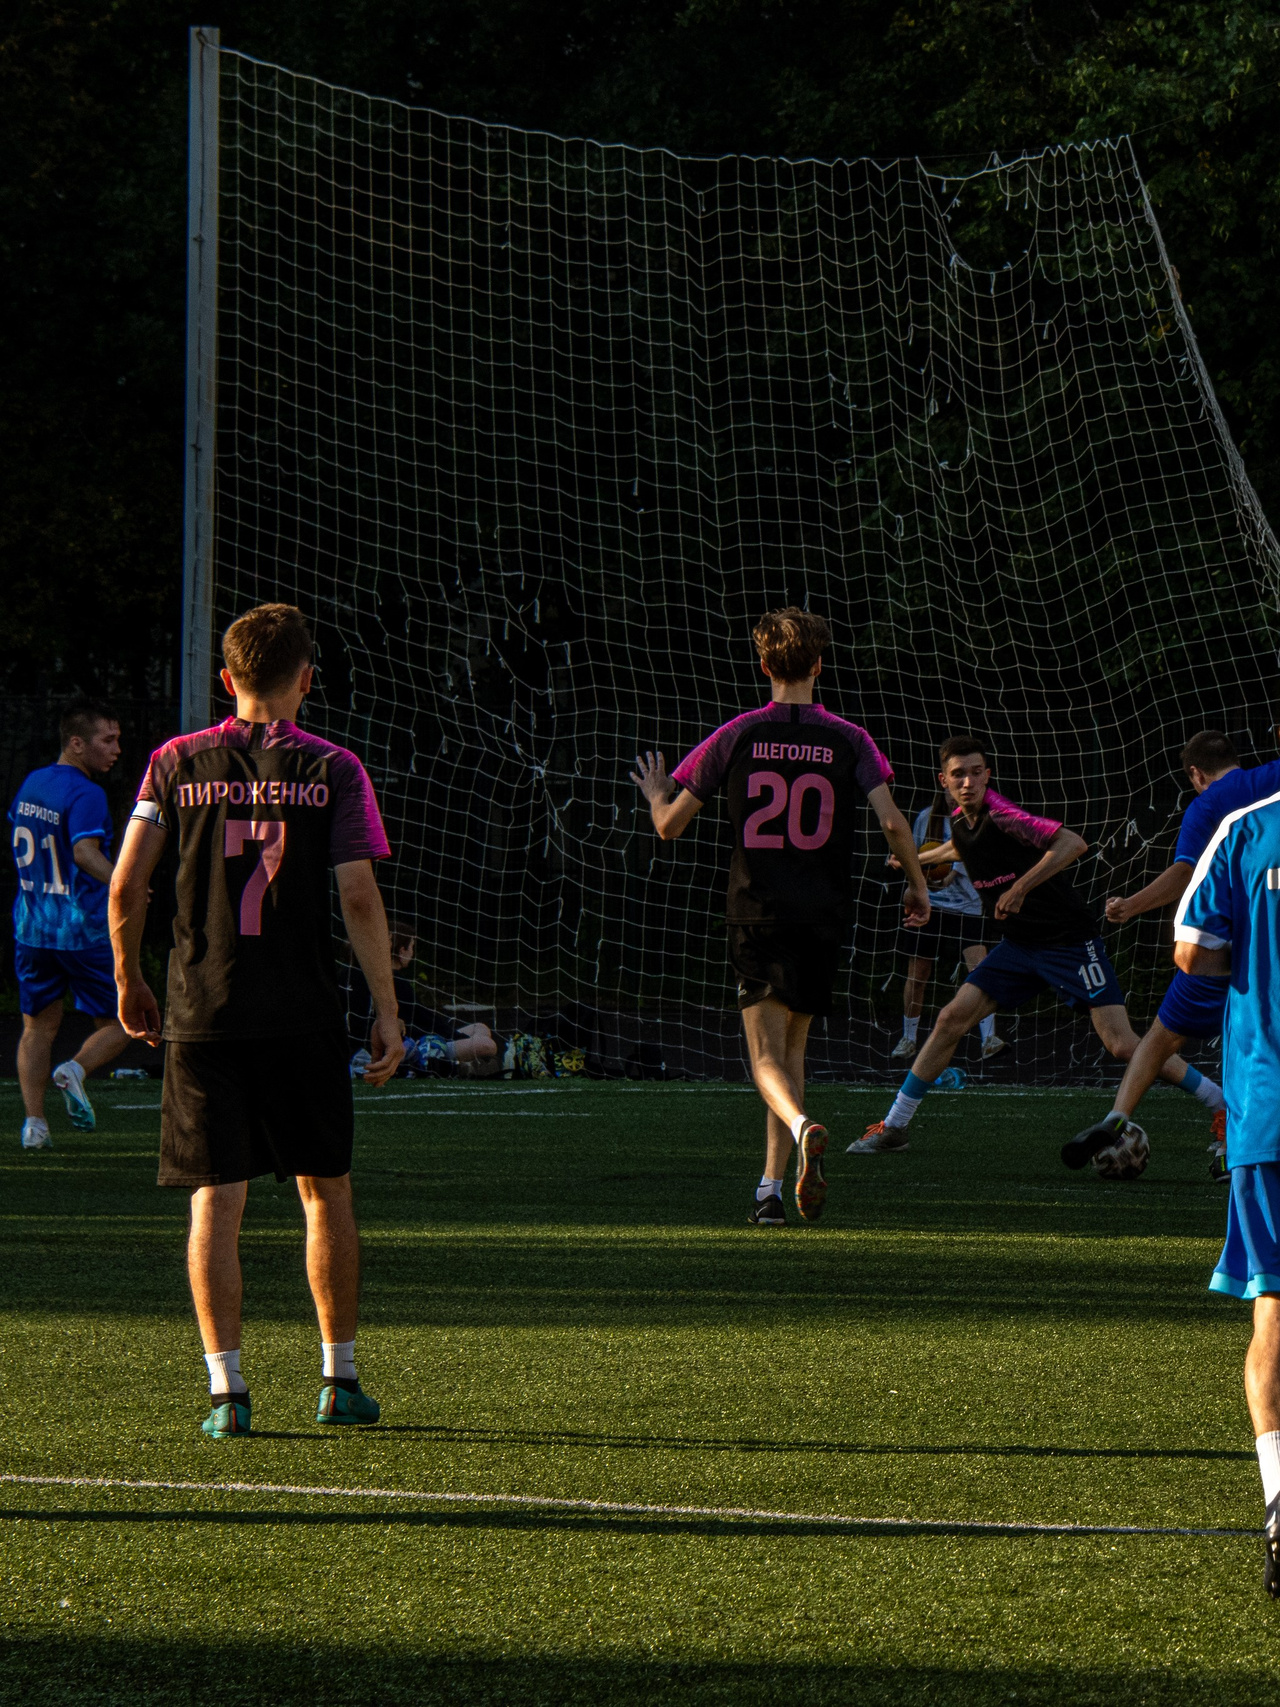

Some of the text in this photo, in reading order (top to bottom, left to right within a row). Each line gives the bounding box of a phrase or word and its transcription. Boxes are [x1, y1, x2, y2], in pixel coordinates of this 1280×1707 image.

[752, 742, 834, 764] ЩЕГОЛЕВ
[176, 781, 330, 808] ПИРОЖЕНКО
[743, 771, 835, 850] 20
[13, 826, 70, 895] 21
[224, 820, 286, 936] 7
[1078, 962, 1107, 990] 10
